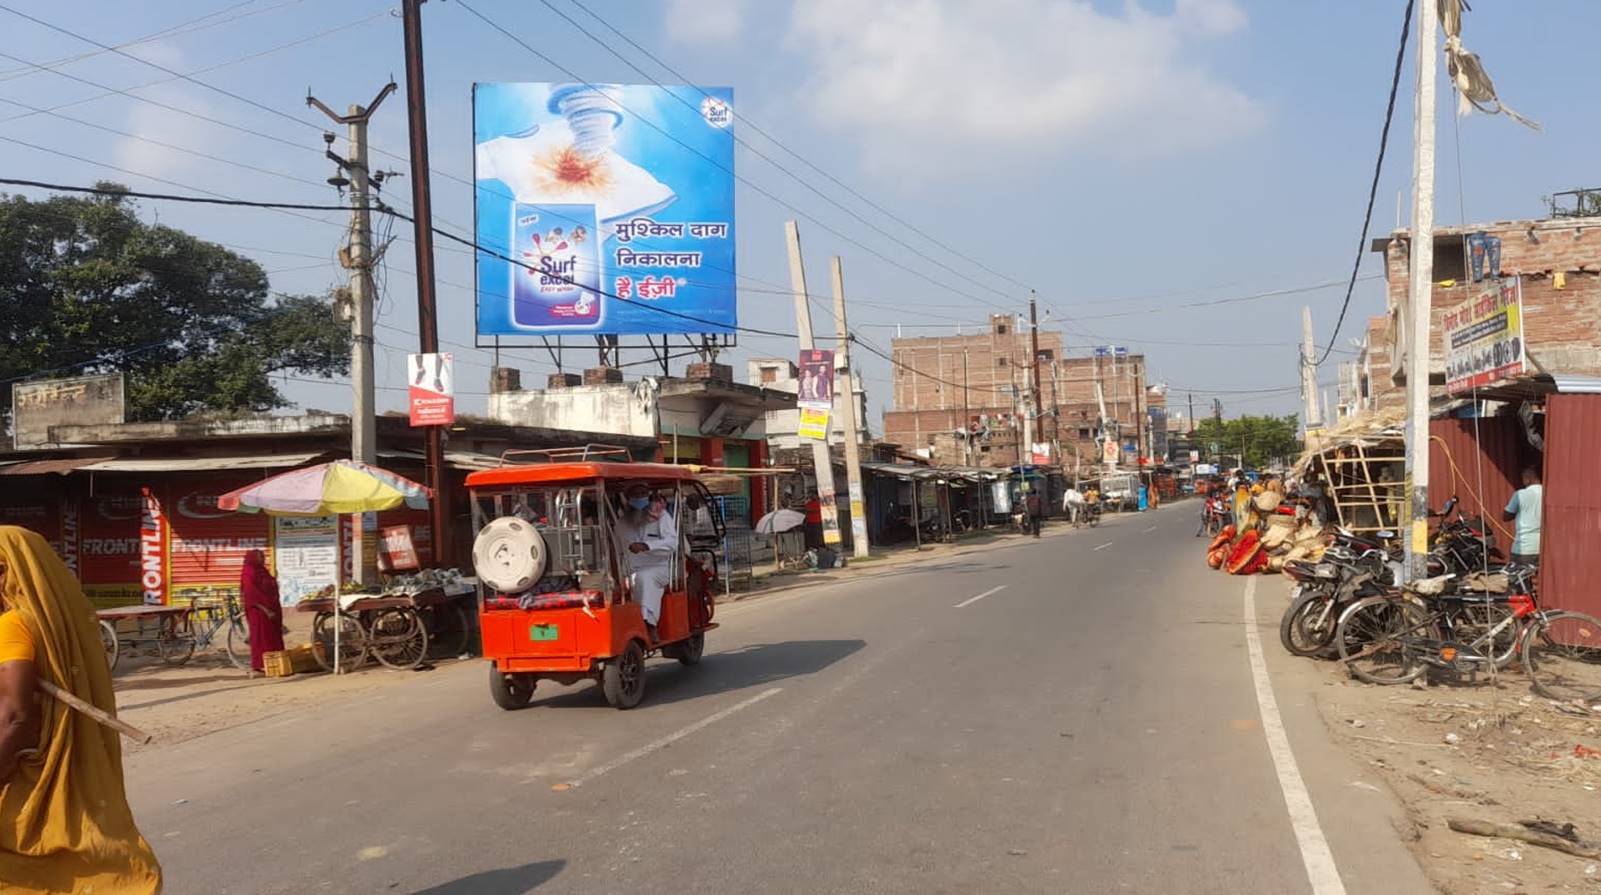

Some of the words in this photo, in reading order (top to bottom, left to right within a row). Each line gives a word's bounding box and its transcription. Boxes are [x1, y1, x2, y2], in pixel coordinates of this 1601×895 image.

[710, 106, 728, 117] Surf
[615, 218, 683, 241] मुश्किल
[690, 223, 726, 237] दाग
[540, 255, 577, 274] Surf
[617, 248, 701, 266] निकालना
[540, 273, 575, 286] excel
[616, 277, 631, 297] है
[83, 537, 140, 555] FRONT
[142, 498, 161, 605] RONTLINE
